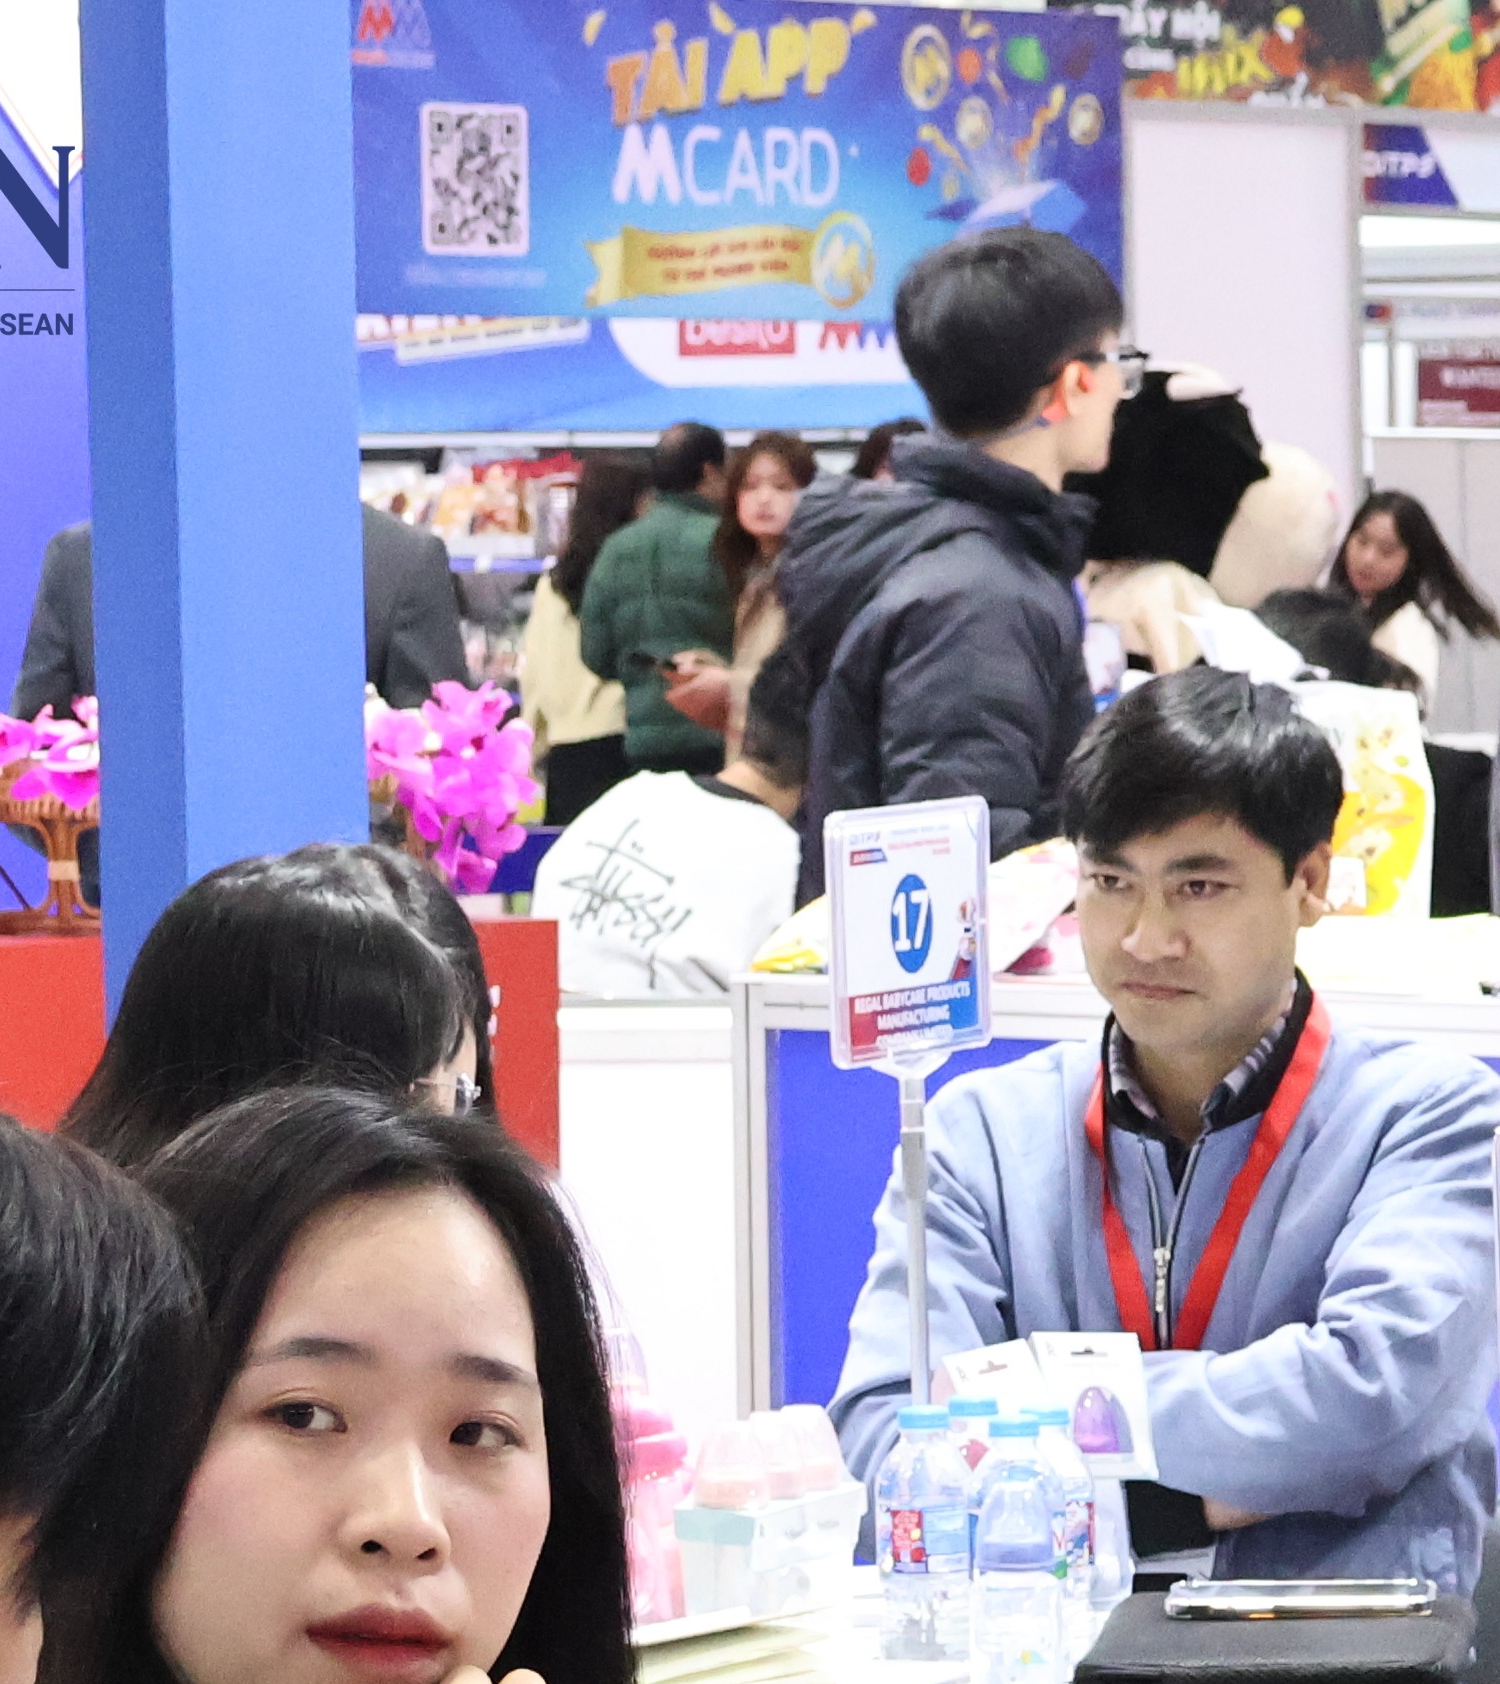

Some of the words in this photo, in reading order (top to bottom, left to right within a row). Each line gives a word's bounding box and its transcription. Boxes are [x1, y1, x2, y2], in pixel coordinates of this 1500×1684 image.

[718, 17, 850, 108] APP
[612, 123, 841, 207] MCARD
[892, 888, 930, 953] 17
